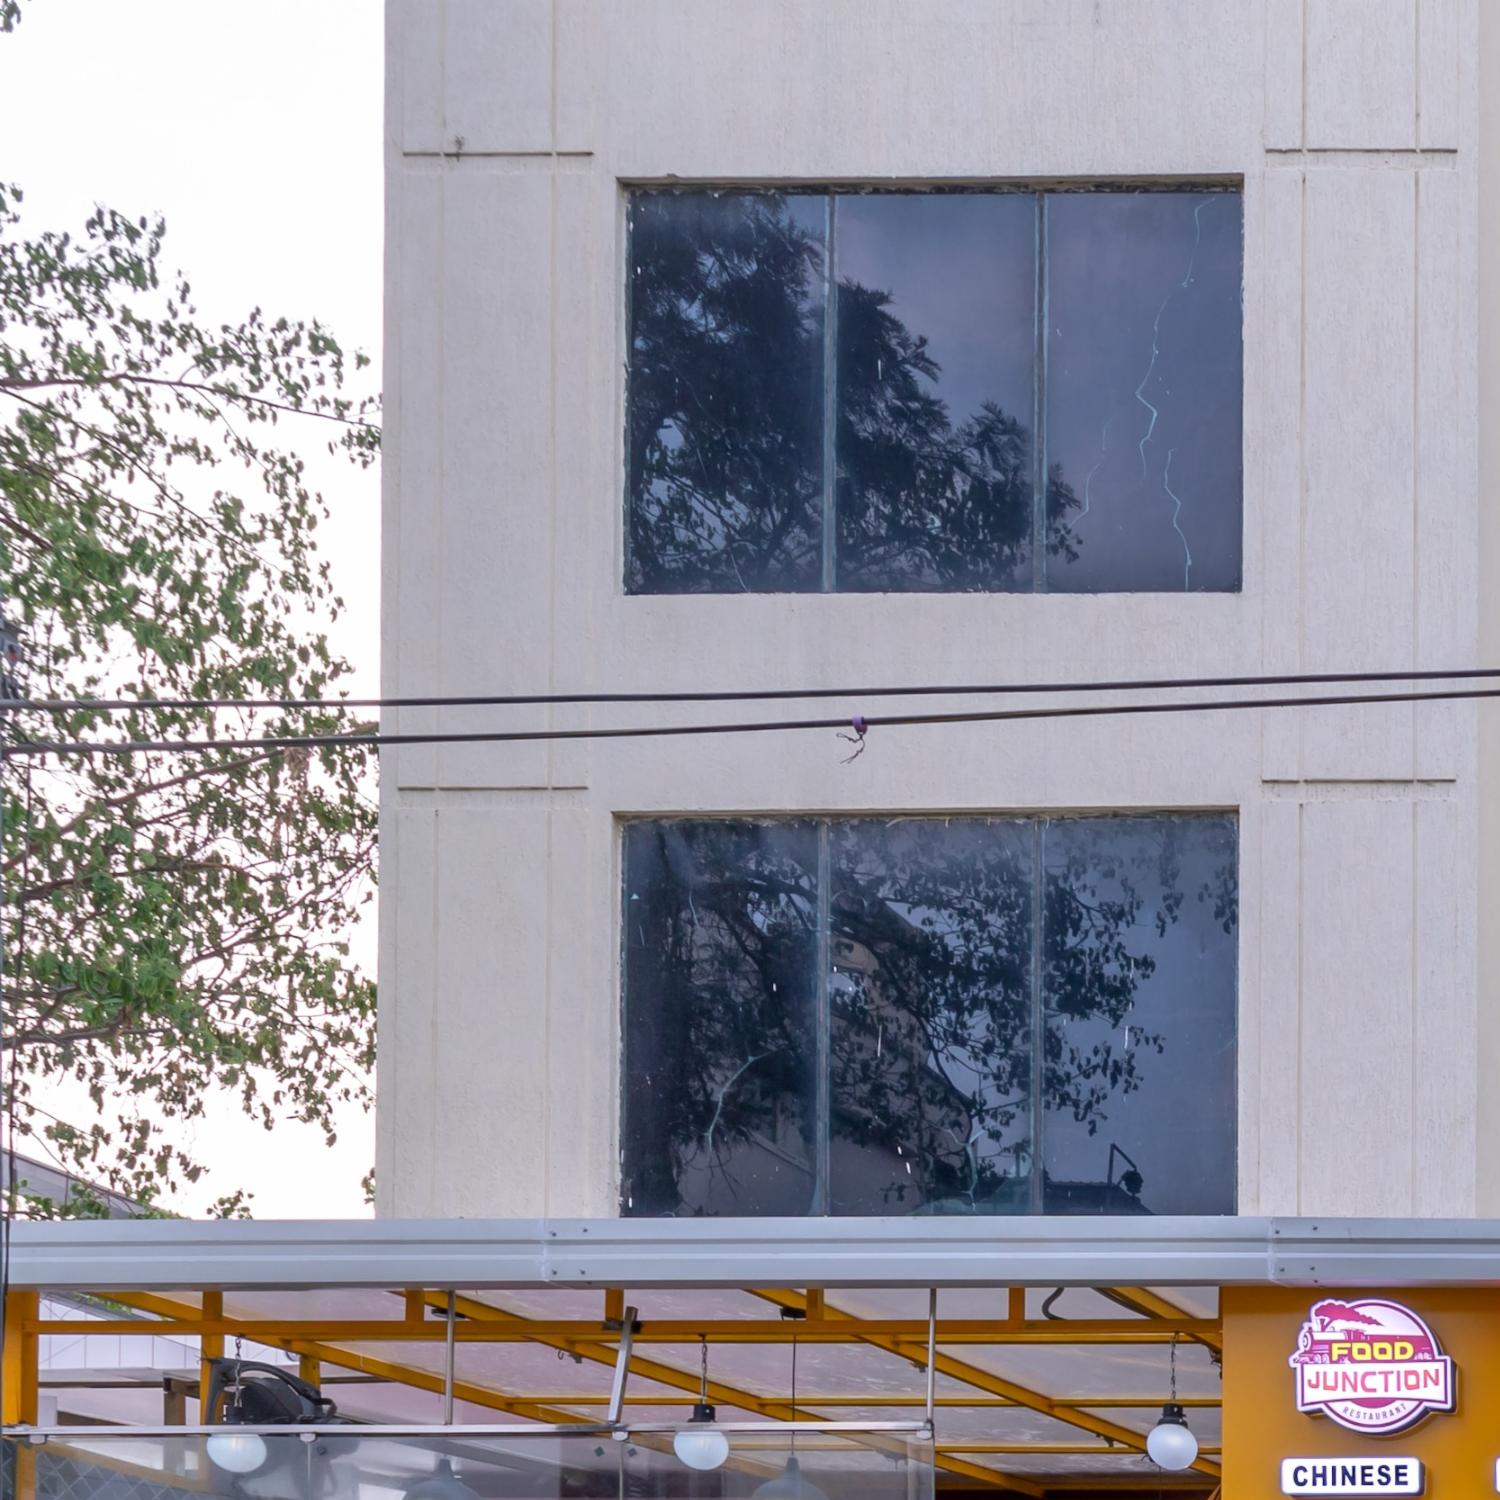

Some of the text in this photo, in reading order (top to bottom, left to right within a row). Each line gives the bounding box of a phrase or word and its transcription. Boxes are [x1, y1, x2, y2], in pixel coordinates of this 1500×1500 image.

[1331, 1341, 1414, 1361] FOOD
[1307, 1369, 1440, 1393] JUNCTION
[1342, 1403, 1407, 1420] RESTAURANT
[1292, 1464, 1409, 1487] CHINESE
